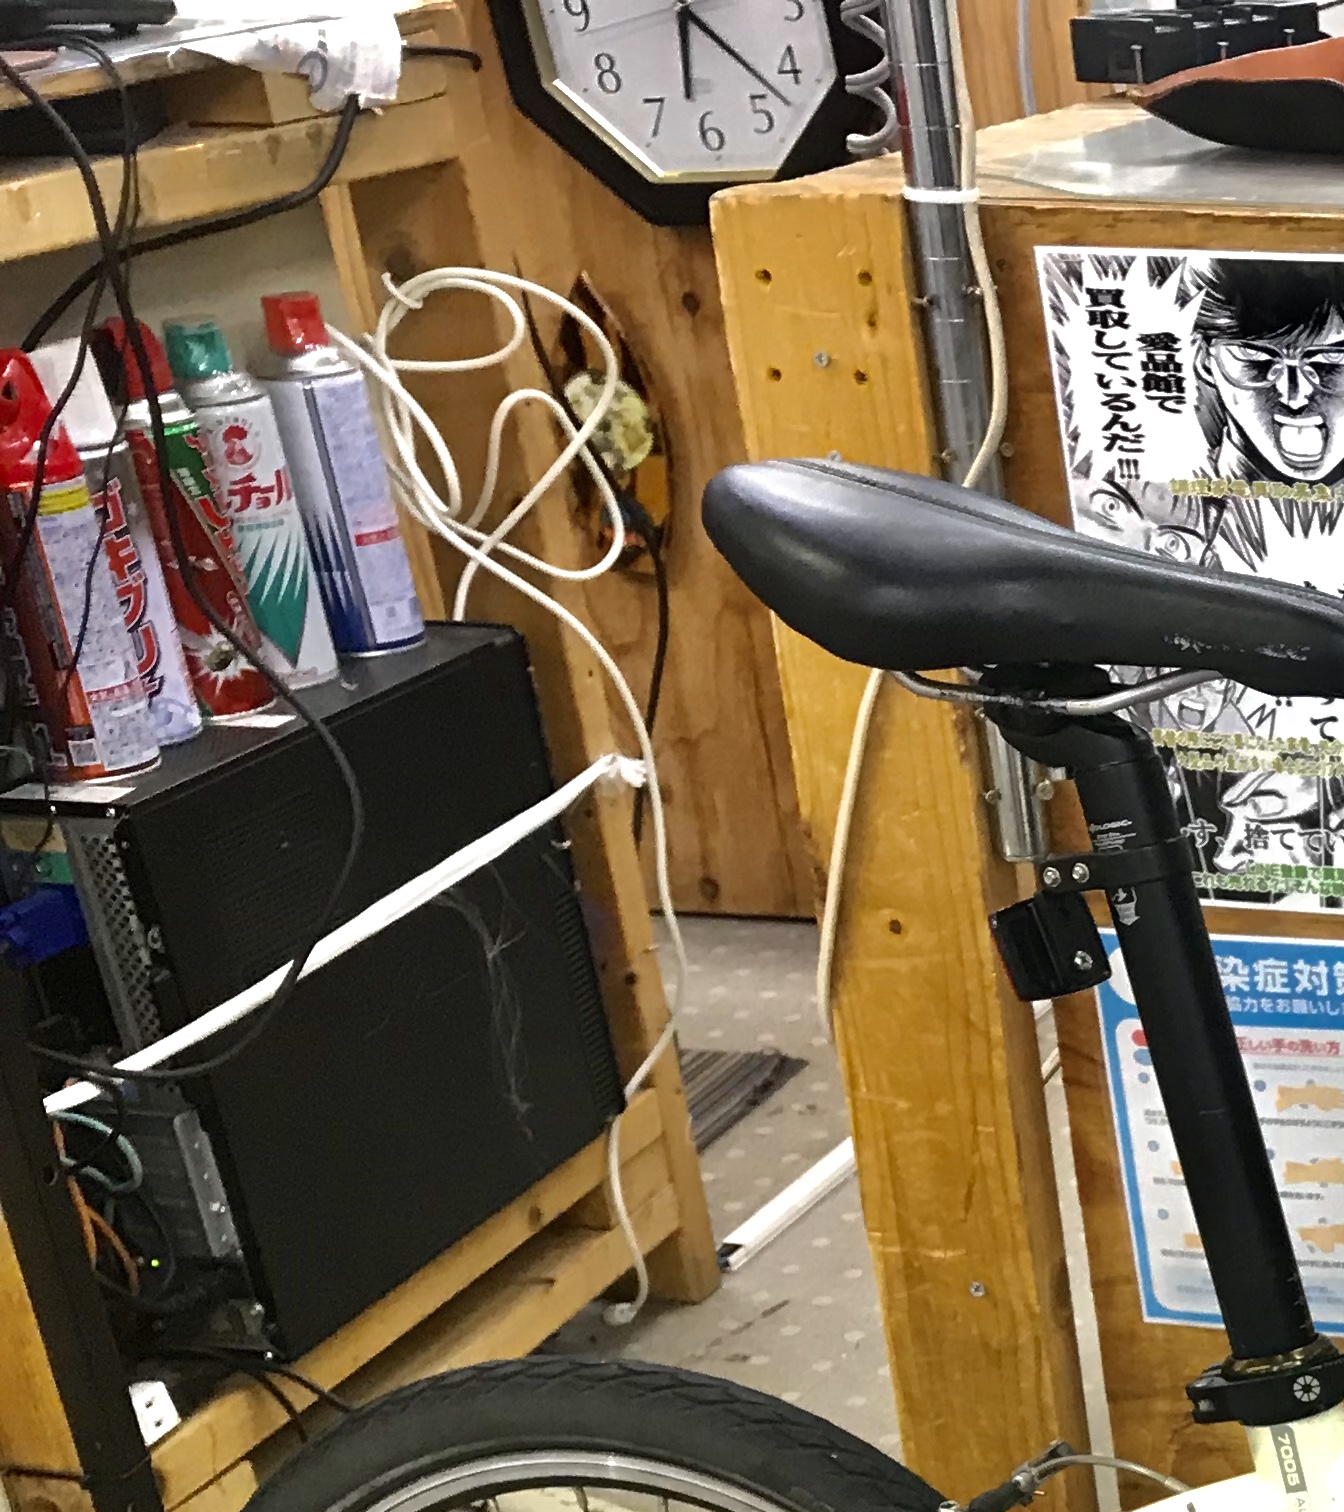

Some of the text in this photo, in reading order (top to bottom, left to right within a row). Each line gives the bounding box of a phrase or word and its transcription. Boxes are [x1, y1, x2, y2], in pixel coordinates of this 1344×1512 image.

[594, 52, 622, 94] 8
[777, 44, 802, 85] 4
[643, 97, 665, 137] 7
[699, 110, 725, 151] 6
[749, 94, 775, 134] 5
[1136, 332, 1187, 414] 愛品館で
